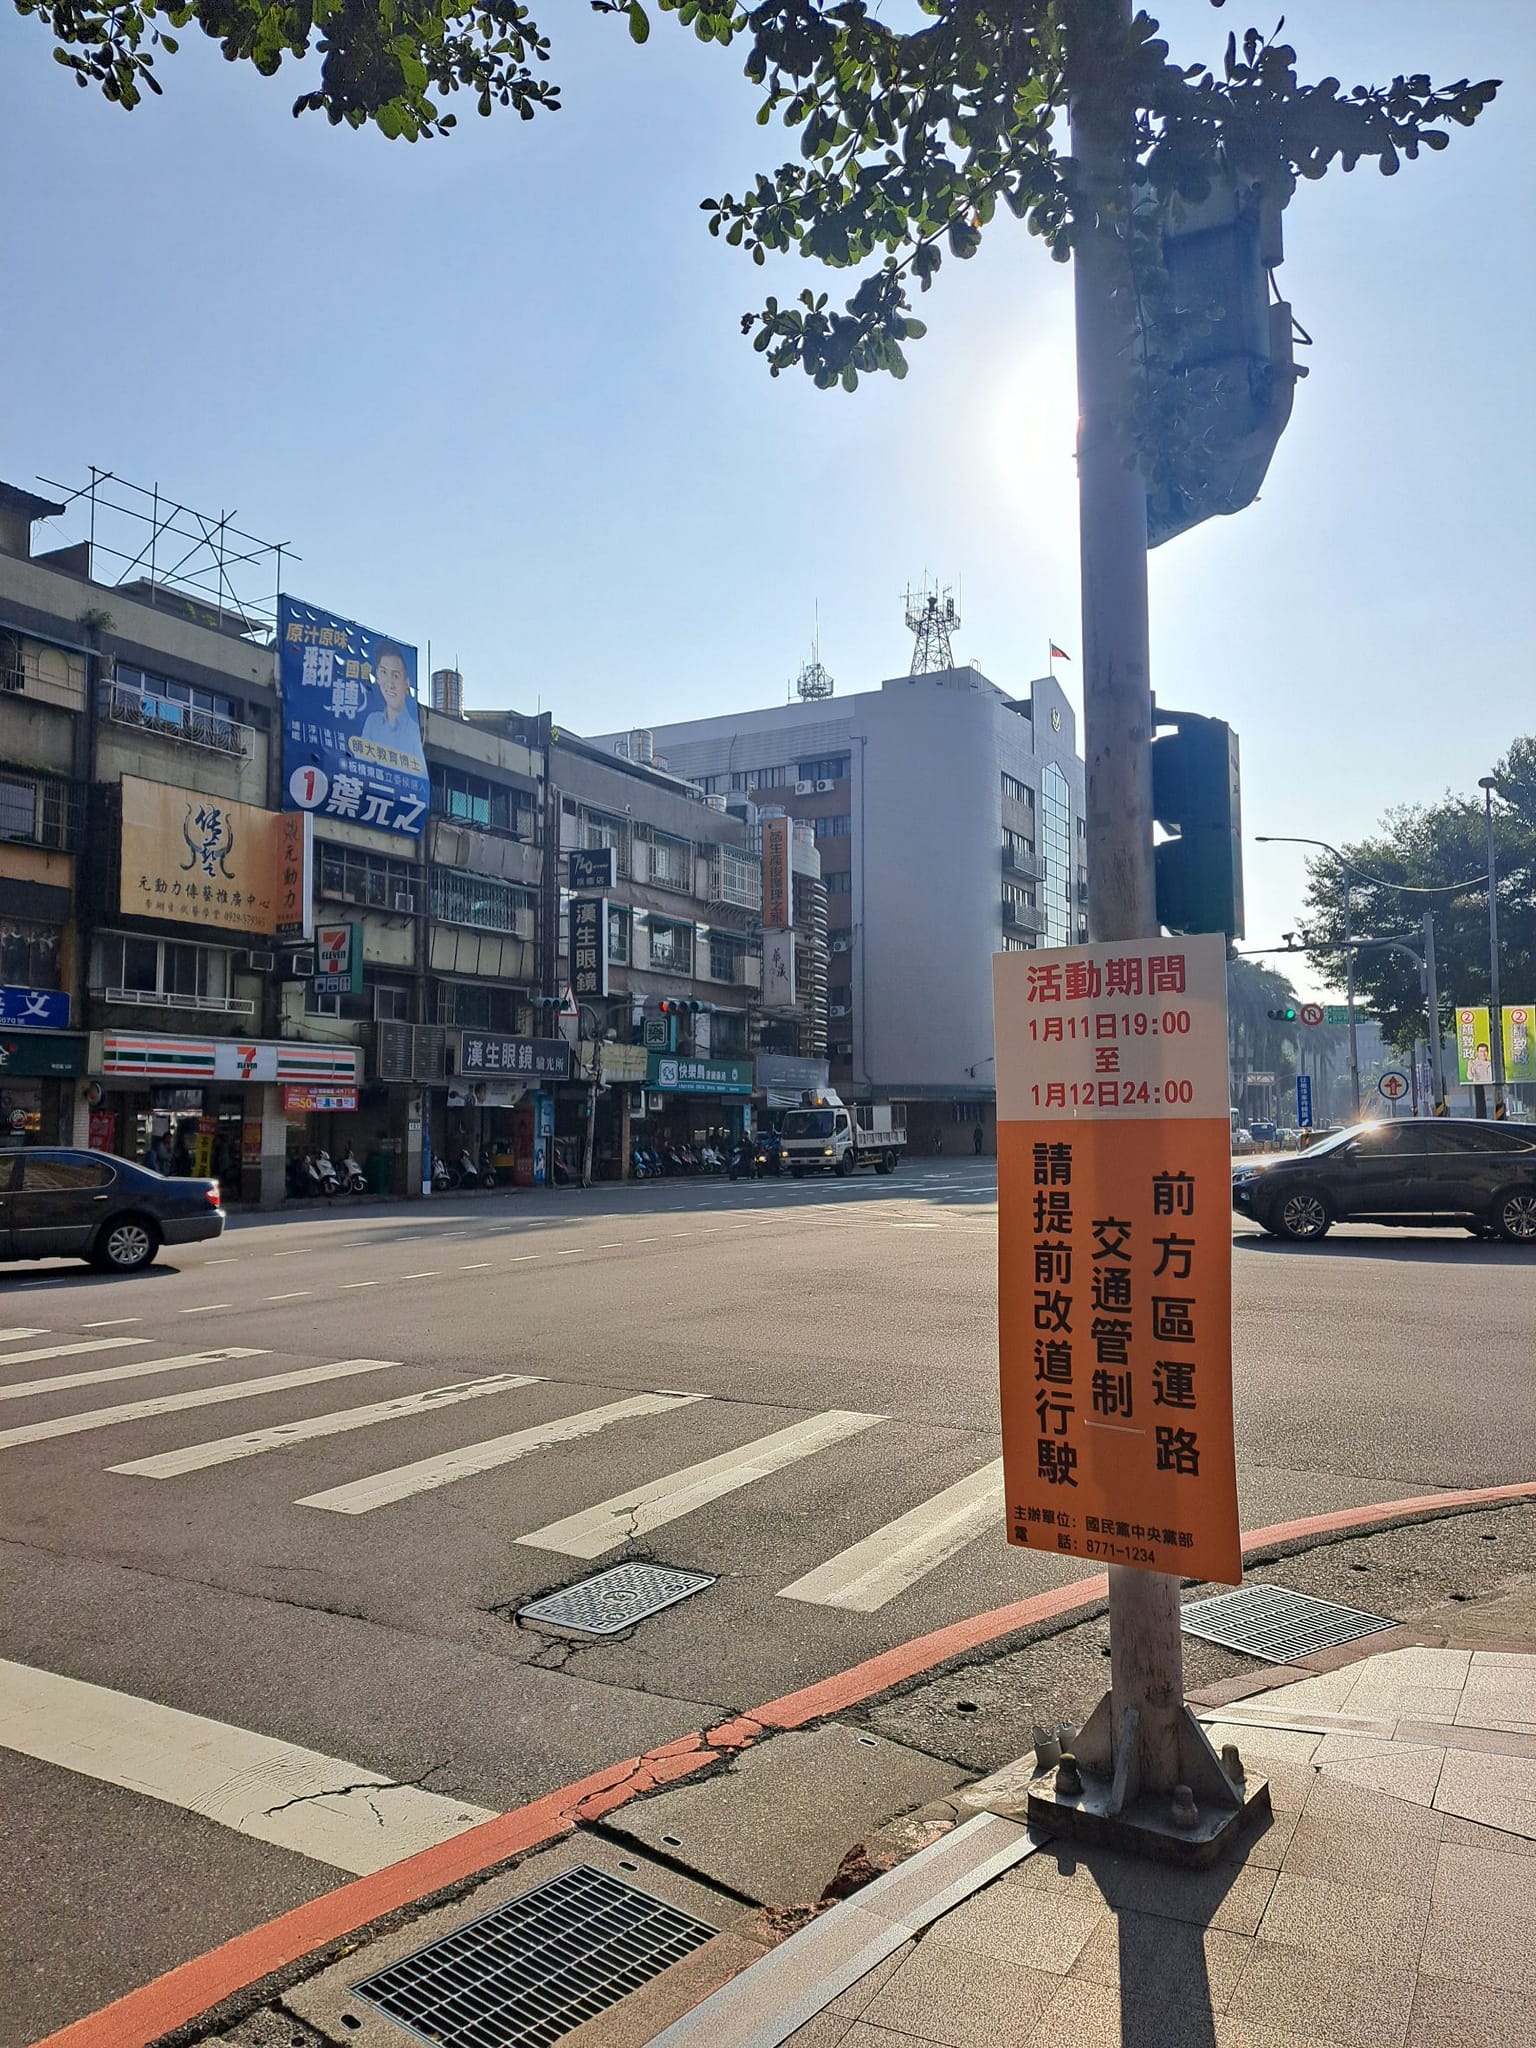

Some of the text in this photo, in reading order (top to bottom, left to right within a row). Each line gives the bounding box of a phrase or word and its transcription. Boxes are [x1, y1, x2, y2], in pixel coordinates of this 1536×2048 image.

[286, 622, 348, 649] 原汁原味
[304, 770, 315, 801] 1
[325, 773, 427, 834] 葉元之
[138, 876, 272, 910] 元動力傳藝推廣中心
[575, 903, 598, 992] 漢生眼鏡
[1026, 955, 1186, 1003] 活動期間
[647, 1023, 664, 1042] 藥
[1028, 1011, 1191, 1042] 1月11日19:00
[467, 1040, 533, 1070] 漢生眼鏡
[1095, 1046, 1121, 1073] 至
[1031, 1079, 1194, 1108] 1月12日24:00
[1032, 1142, 1079, 1488] 請提前改道行駛
[1091, 1216, 1133, 1418] 交通管制
[1151, 1170, 1201, 1477] 前方區運路
[1085, 1515, 1194, 1549] 國民黨中央黨部
[1086, 1539, 1156, 1564] 8771-1234
